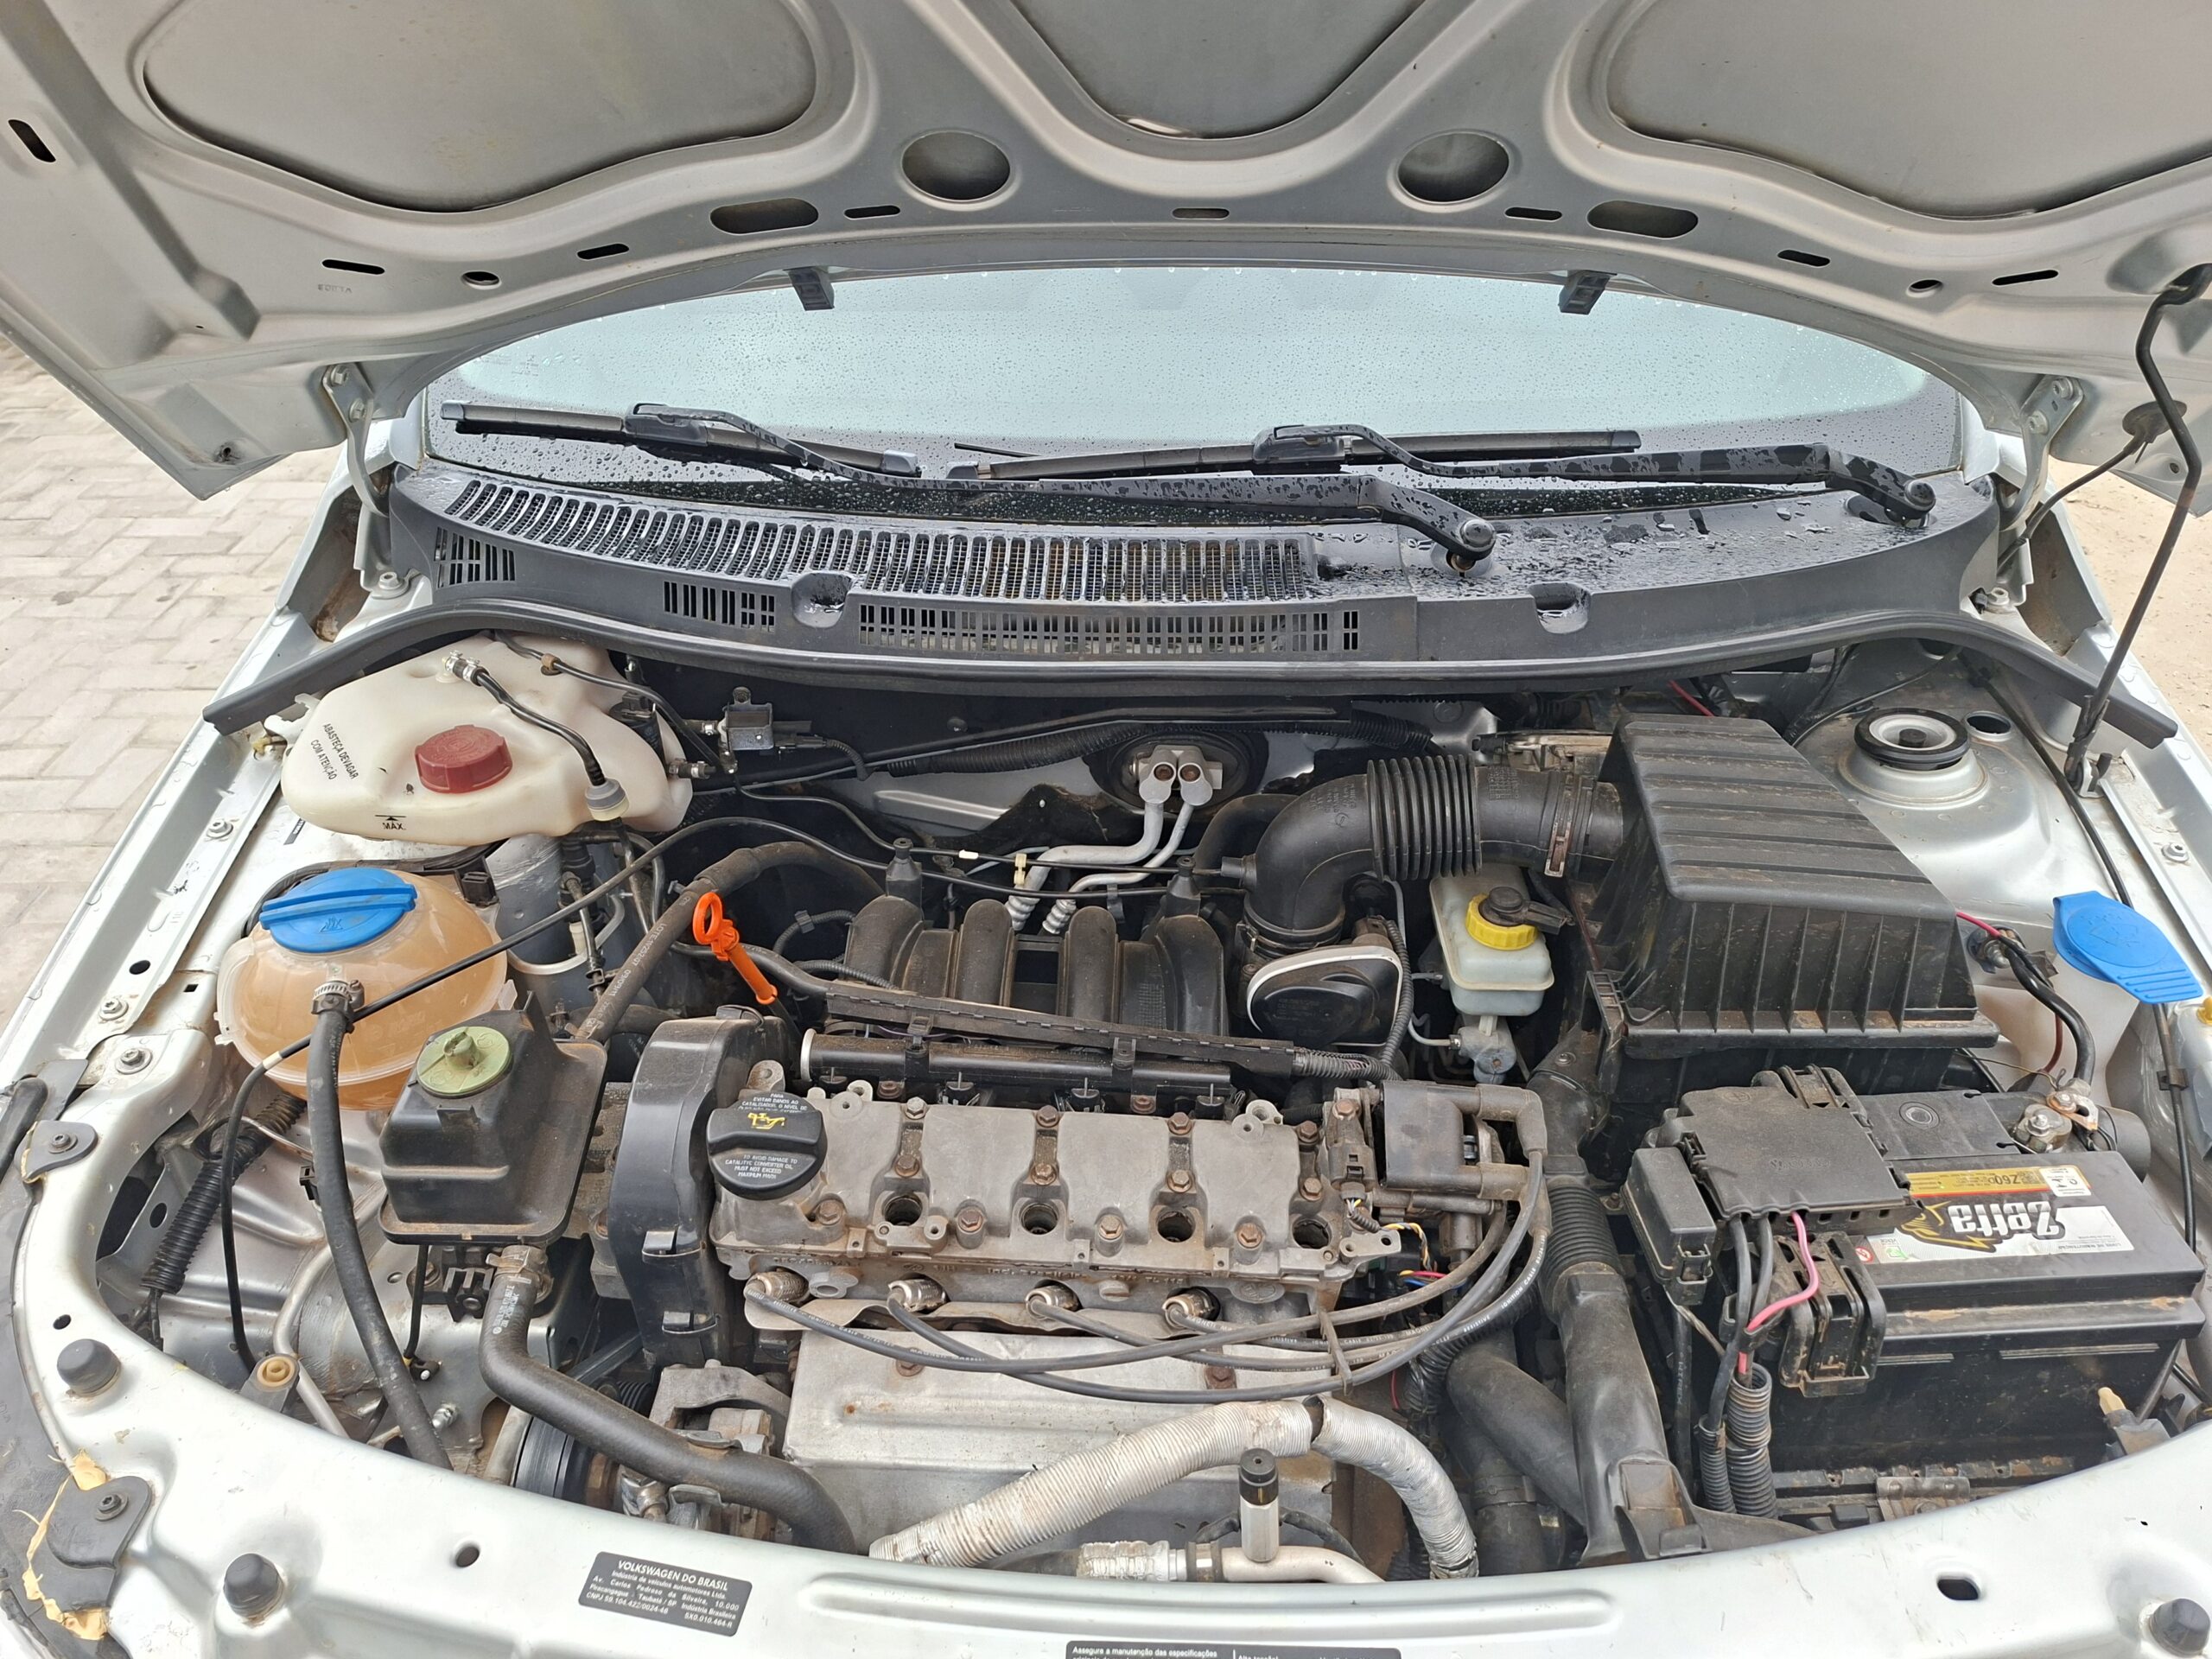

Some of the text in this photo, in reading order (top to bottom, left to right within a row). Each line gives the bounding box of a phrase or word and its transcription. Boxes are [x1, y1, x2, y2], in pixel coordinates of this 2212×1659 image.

[311, 739, 337, 780] COM ATENÇÃO
[322, 723, 359, 779] ABASTEÇA DEVAGAR
[1948, 1201, 2061, 1237] Zetta
[1501, 1286, 1523, 1309] IGNITION
[1524, 1268, 1536, 1285] CABLE
[1186, 1314, 1217, 1329] MAGNETI
[610, 1579, 631, 1589] Carlos
[611, 1570, 638, 1582] Indústria
[673, 1584, 710, 1597] automotores
[618, 1560, 728, 1591] VOLKSWAGEN DO BRASIL
[586, 1591, 604, 1601] CNPJ
[1072, 1646, 1104, 1655] Assegure
[1112, 1647, 1153, 1657] manutenção
[1155, 1648, 1167, 1656] das
